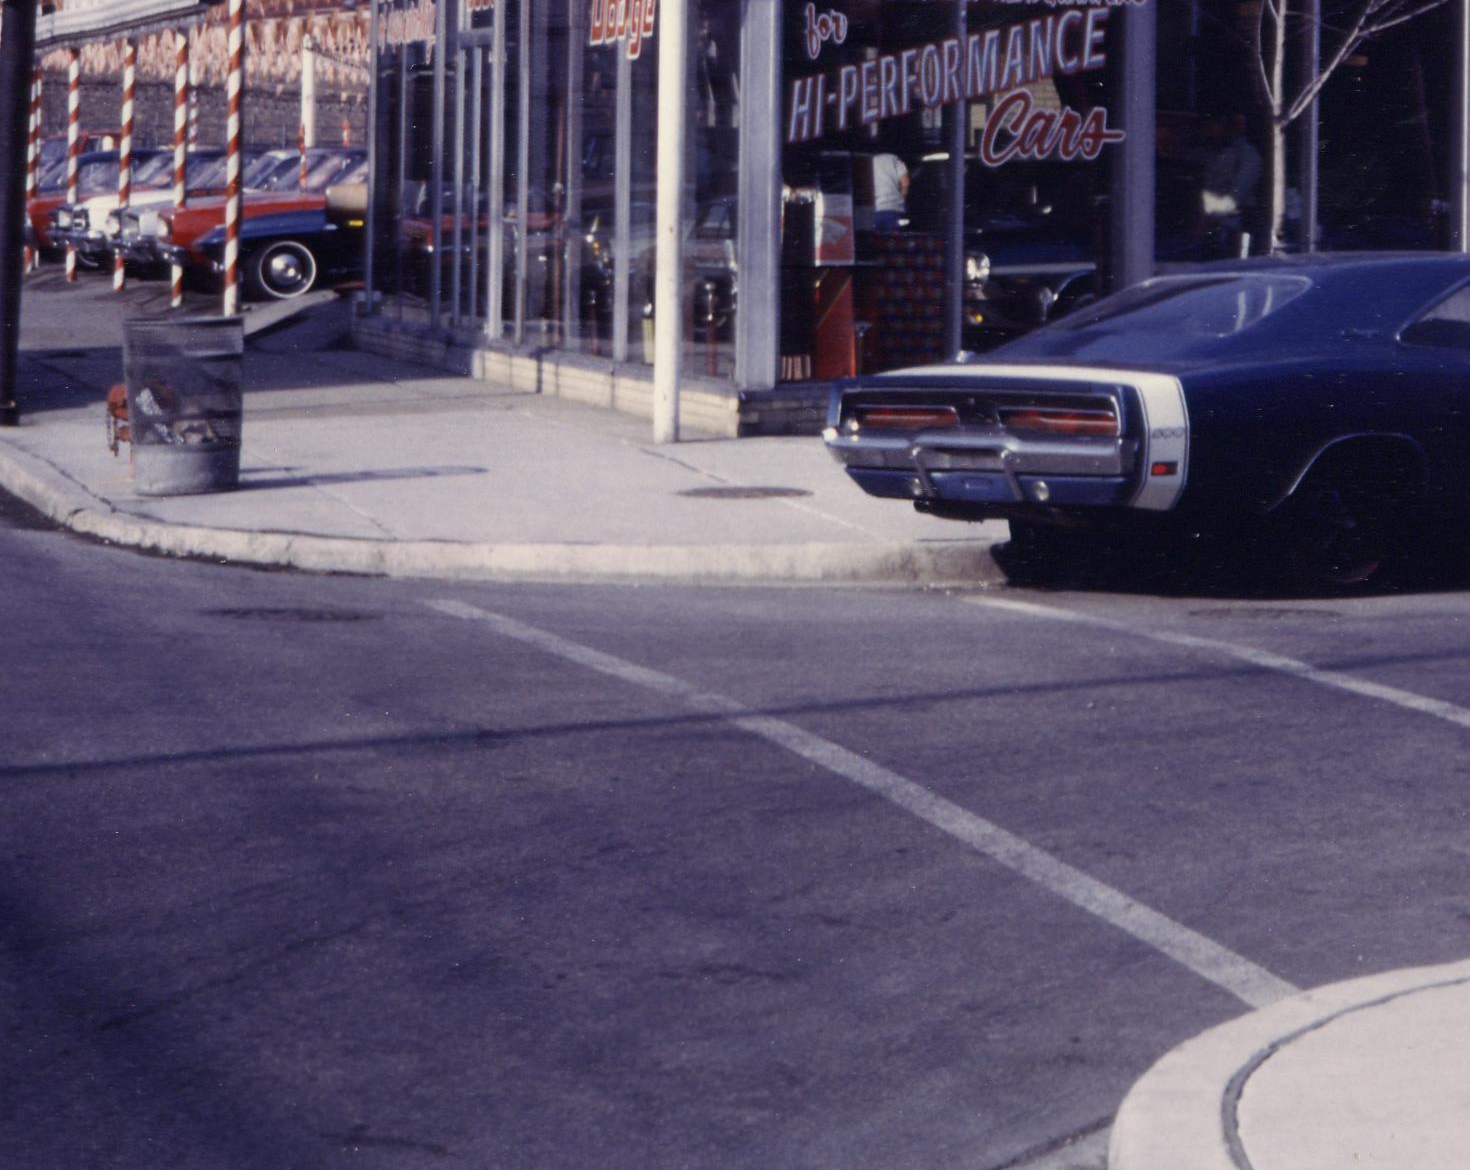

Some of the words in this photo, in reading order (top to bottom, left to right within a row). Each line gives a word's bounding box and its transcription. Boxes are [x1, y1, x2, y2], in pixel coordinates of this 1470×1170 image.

[804, 2, 848, 60] for
[786, 6, 1110, 143] HI-PERFORMANCE
[980, 87, 1125, 167] Cars
